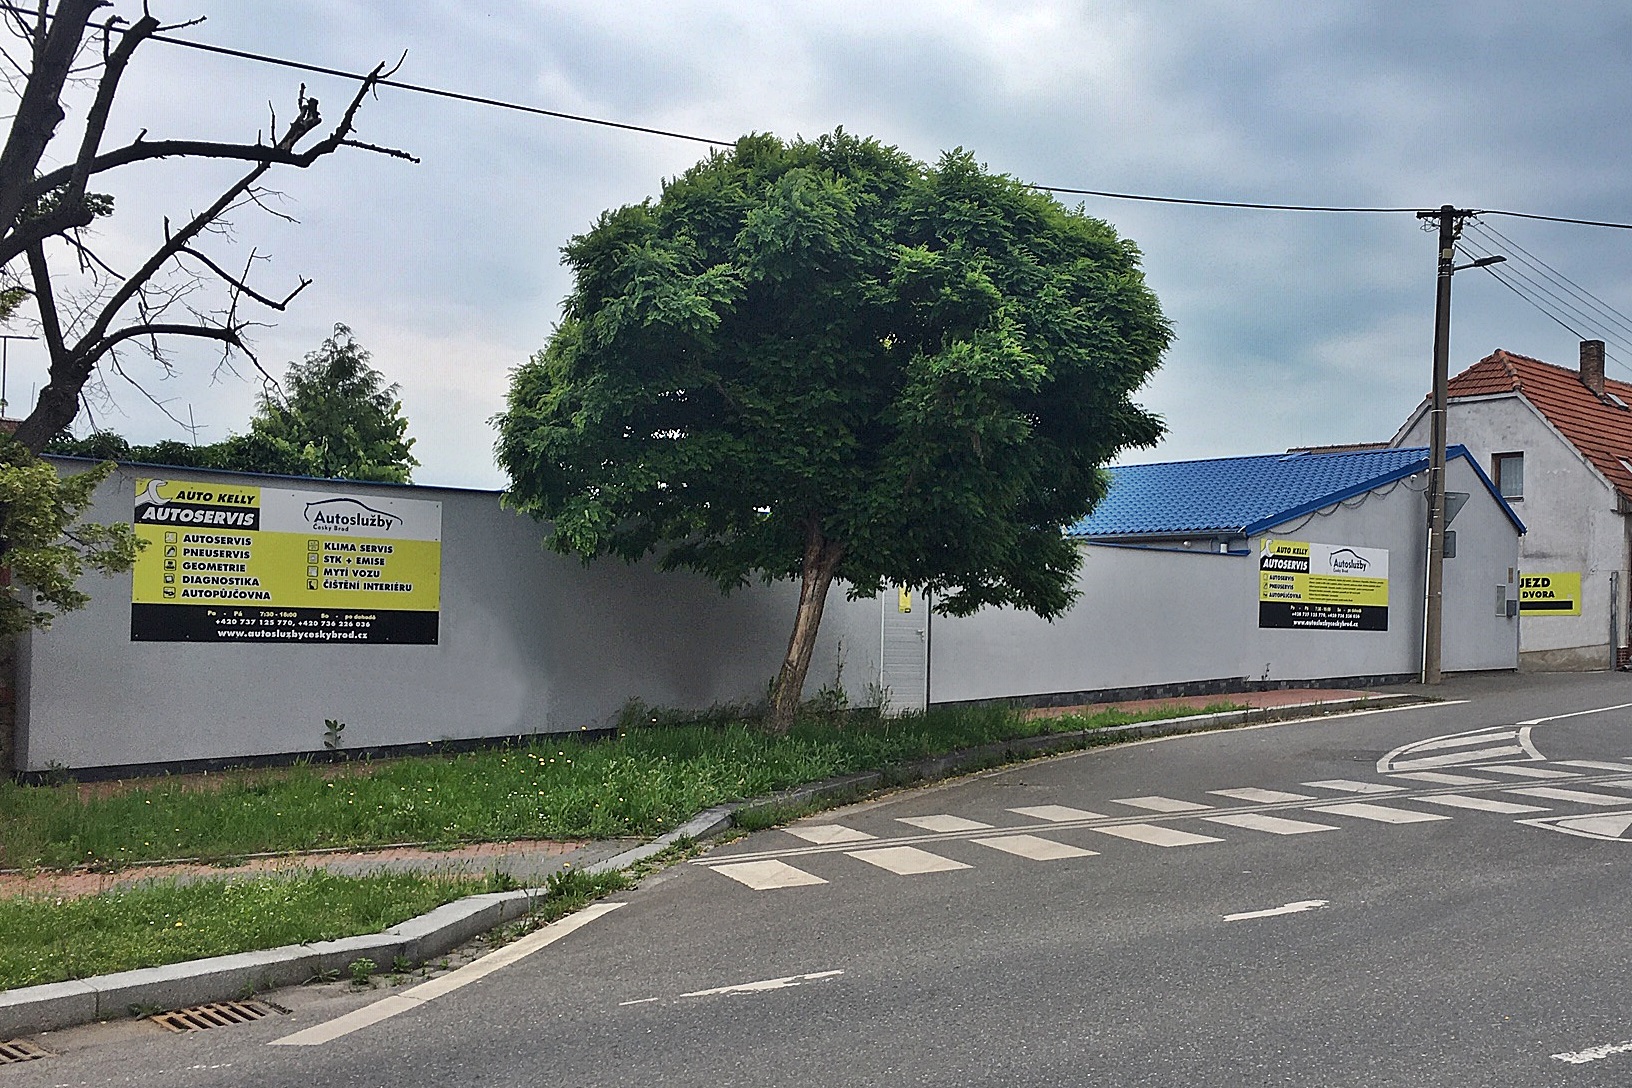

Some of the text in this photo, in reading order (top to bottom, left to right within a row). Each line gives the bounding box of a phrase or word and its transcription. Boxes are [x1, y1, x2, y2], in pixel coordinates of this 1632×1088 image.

[176, 490, 255, 504] AUTO KELLY
[142, 506, 255, 526] AUTOSERVIS
[314, 510, 393, 530] Autoslužby
[183, 535, 252, 546] AUTOSERVIS
[324, 542, 393, 553] KLIMA SERVIS
[183, 548, 250, 559] PNEUSERVIS
[324, 556, 342, 564] STK
[356, 557, 385, 566] EMISE
[1263, 559, 1308, 571] AUTOSERVIS
[1334, 559, 1367, 572] Autoslužby
[182, 562, 246, 572] GEOMETRIE
[324, 567, 380, 578] MYTÍ VOZU
[182, 576, 259, 586] DIAGNOSTIKA
[323, 580, 412, 592] ČIŠTĚNÍ INTERIÉRU
[182, 588, 270, 600] AUTOPŮJČOVNA
